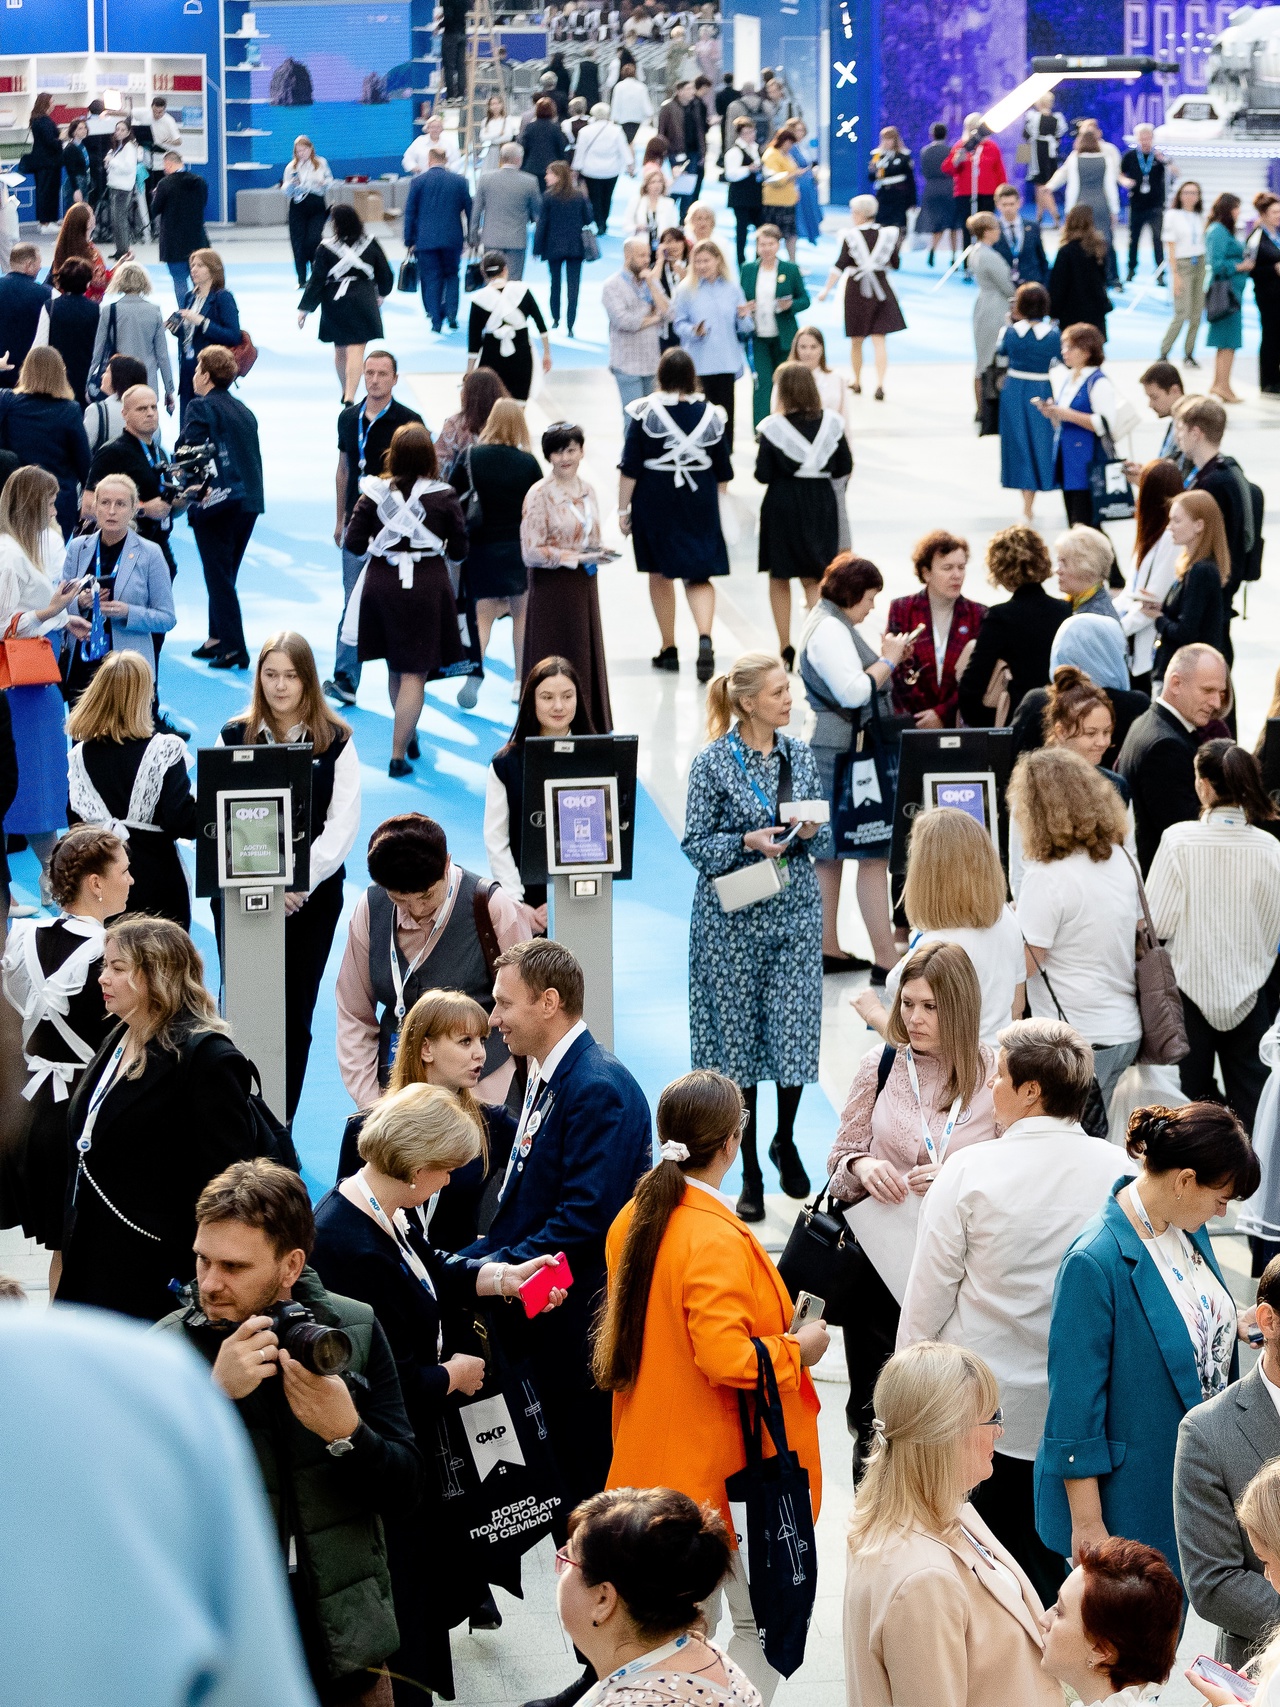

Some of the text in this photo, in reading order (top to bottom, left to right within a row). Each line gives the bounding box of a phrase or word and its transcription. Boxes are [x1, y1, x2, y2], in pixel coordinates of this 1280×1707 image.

[562, 795, 597, 809] ФКР
[942, 789, 975, 803] ФКР
[235, 807, 269, 821] ФКР
[1172, 1267, 1184, 1281] ФКР
[1200, 1294, 1210, 1310] ФКР
[475, 1425, 507, 1445] ФКР
[491, 1496, 536, 1523] ДОБРО
[469, 1496, 562, 1540] ПОЖАЛОВАТЬ
[488, 1510, 554, 1544] В СЕМЬЮ!
